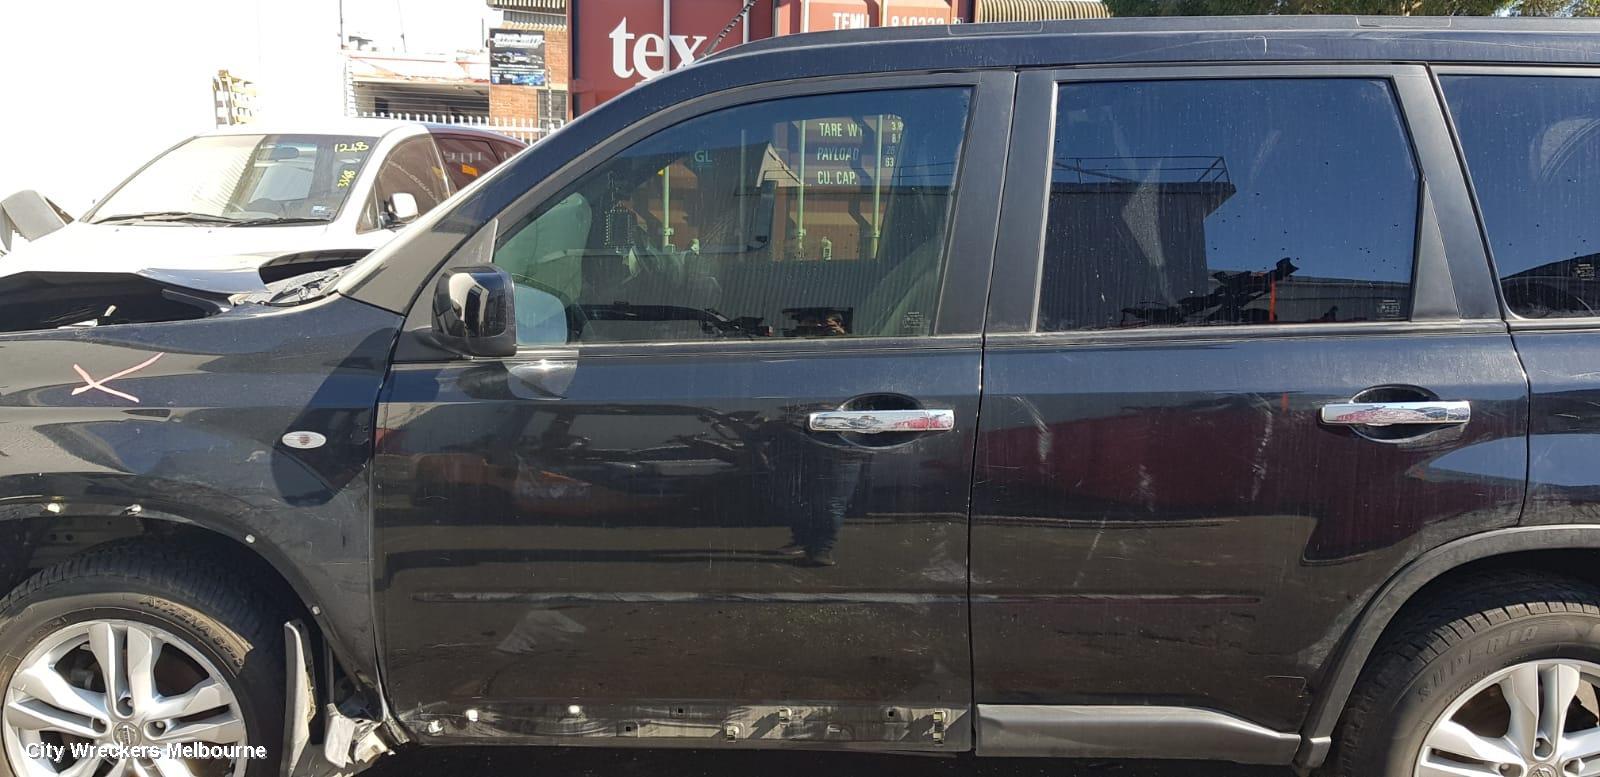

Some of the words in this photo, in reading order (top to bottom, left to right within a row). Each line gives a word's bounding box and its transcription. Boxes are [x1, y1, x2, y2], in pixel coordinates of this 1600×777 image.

[608, 17, 707, 80] tex
[819, 122, 842, 136] TARE
[817, 147, 859, 160] PAYLOAD
[817, 170, 833, 185] CU.
[836, 171, 857, 185] CAP.
